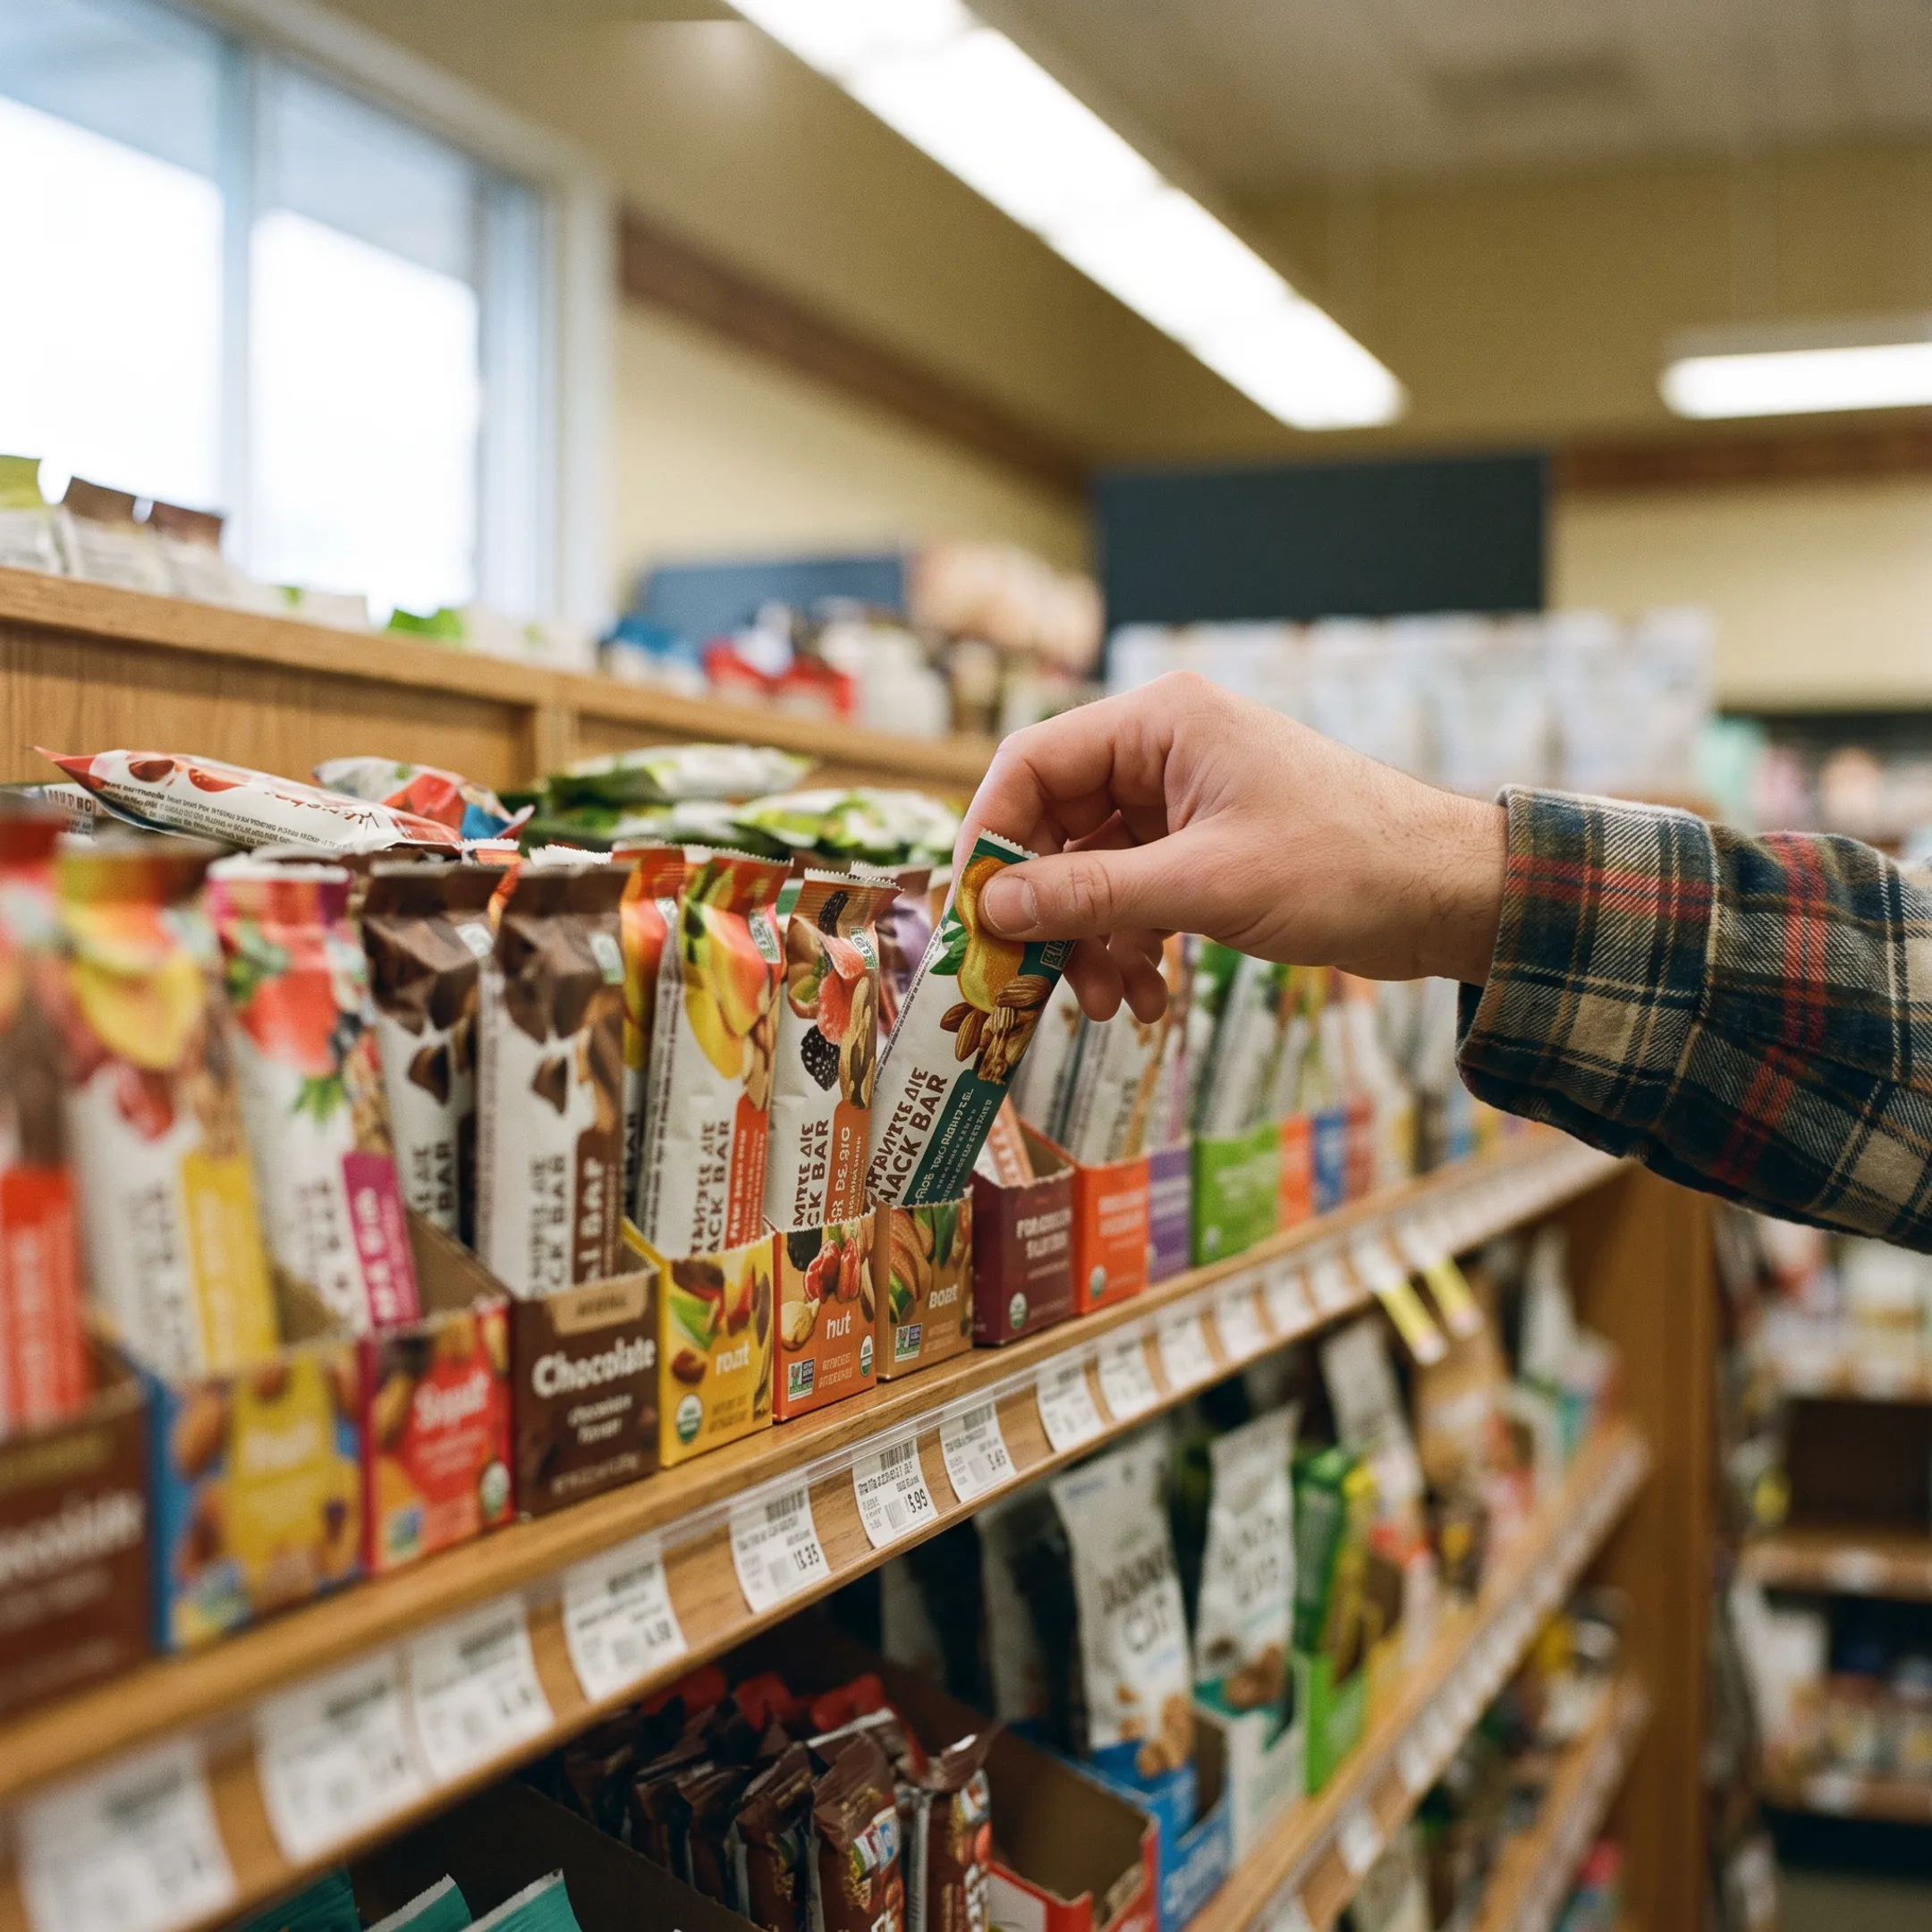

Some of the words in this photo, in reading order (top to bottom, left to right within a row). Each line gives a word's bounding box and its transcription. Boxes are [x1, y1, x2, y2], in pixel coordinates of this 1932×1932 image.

[910, 1074, 948, 1131] BAR
[715, 1119, 731, 1183] BAR
[813, 1119, 830, 1180] BAR
[826, 1309, 852, 1340] nut
[531, 1335, 656, 1400] Chocolate
